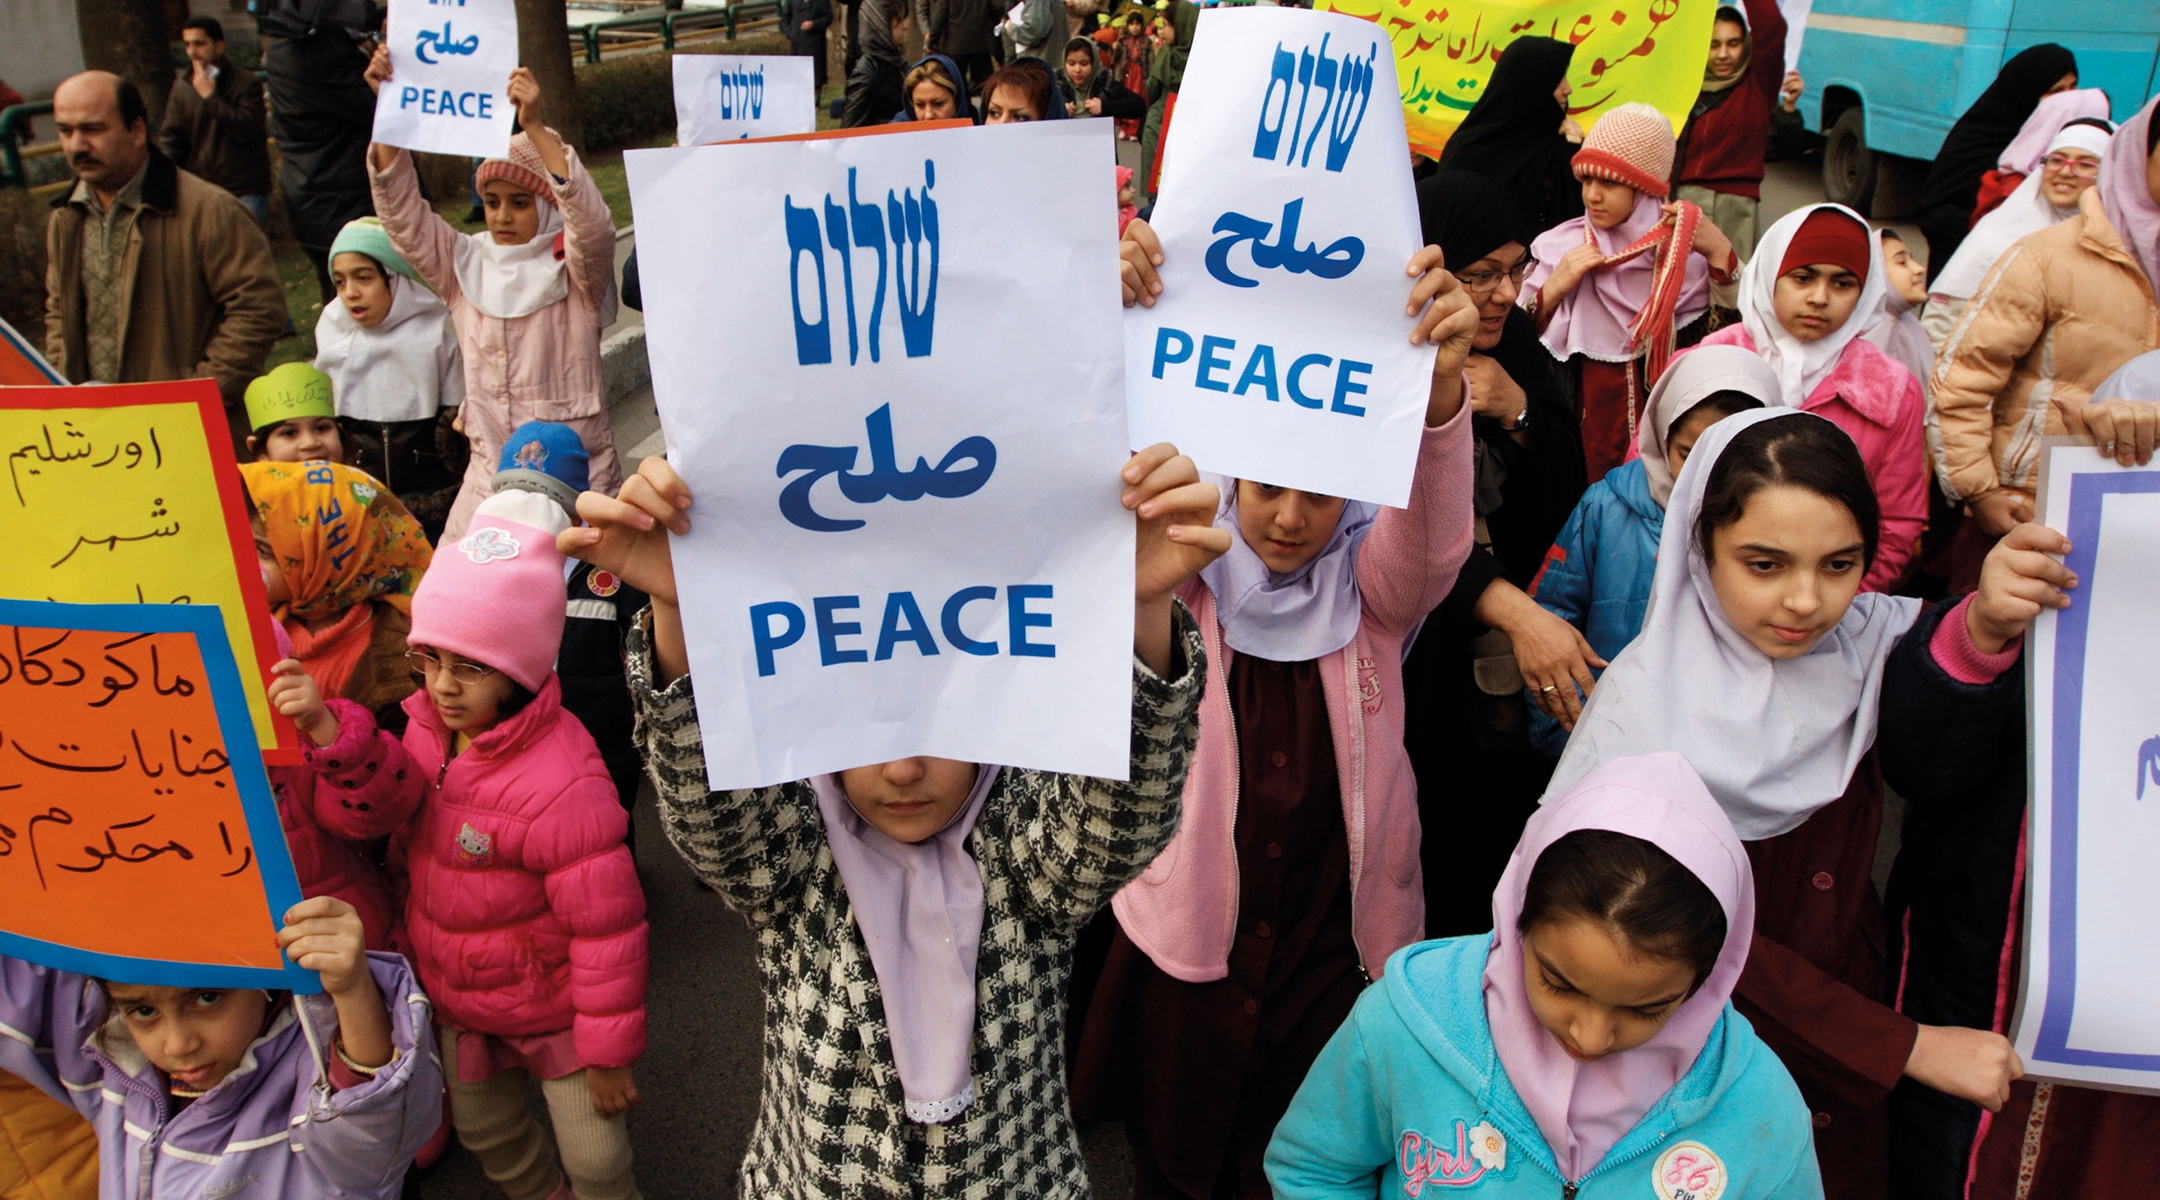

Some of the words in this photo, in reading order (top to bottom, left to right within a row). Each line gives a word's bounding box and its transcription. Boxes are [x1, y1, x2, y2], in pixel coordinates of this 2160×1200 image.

[415, 20, 479, 65] صلح
[400, 86, 493, 119] PEACE
[1205, 197, 1365, 288] صلح
[1152, 327, 1373, 418] PEACE
[9, 420, 162, 508] اورشلیم
[776, 402, 997, 532] صلح
[317, 497, 356, 572] THE
[749, 584, 1057, 678] PEACE
[151, 644, 195, 697] ما
[11, 728, 231, 796] جنایات
[28, 807, 194, 892] محکوم
[220, 821, 251, 877] را
[1400, 1120, 1487, 1198] Girl
[1666, 1154, 1716, 1191] 86
